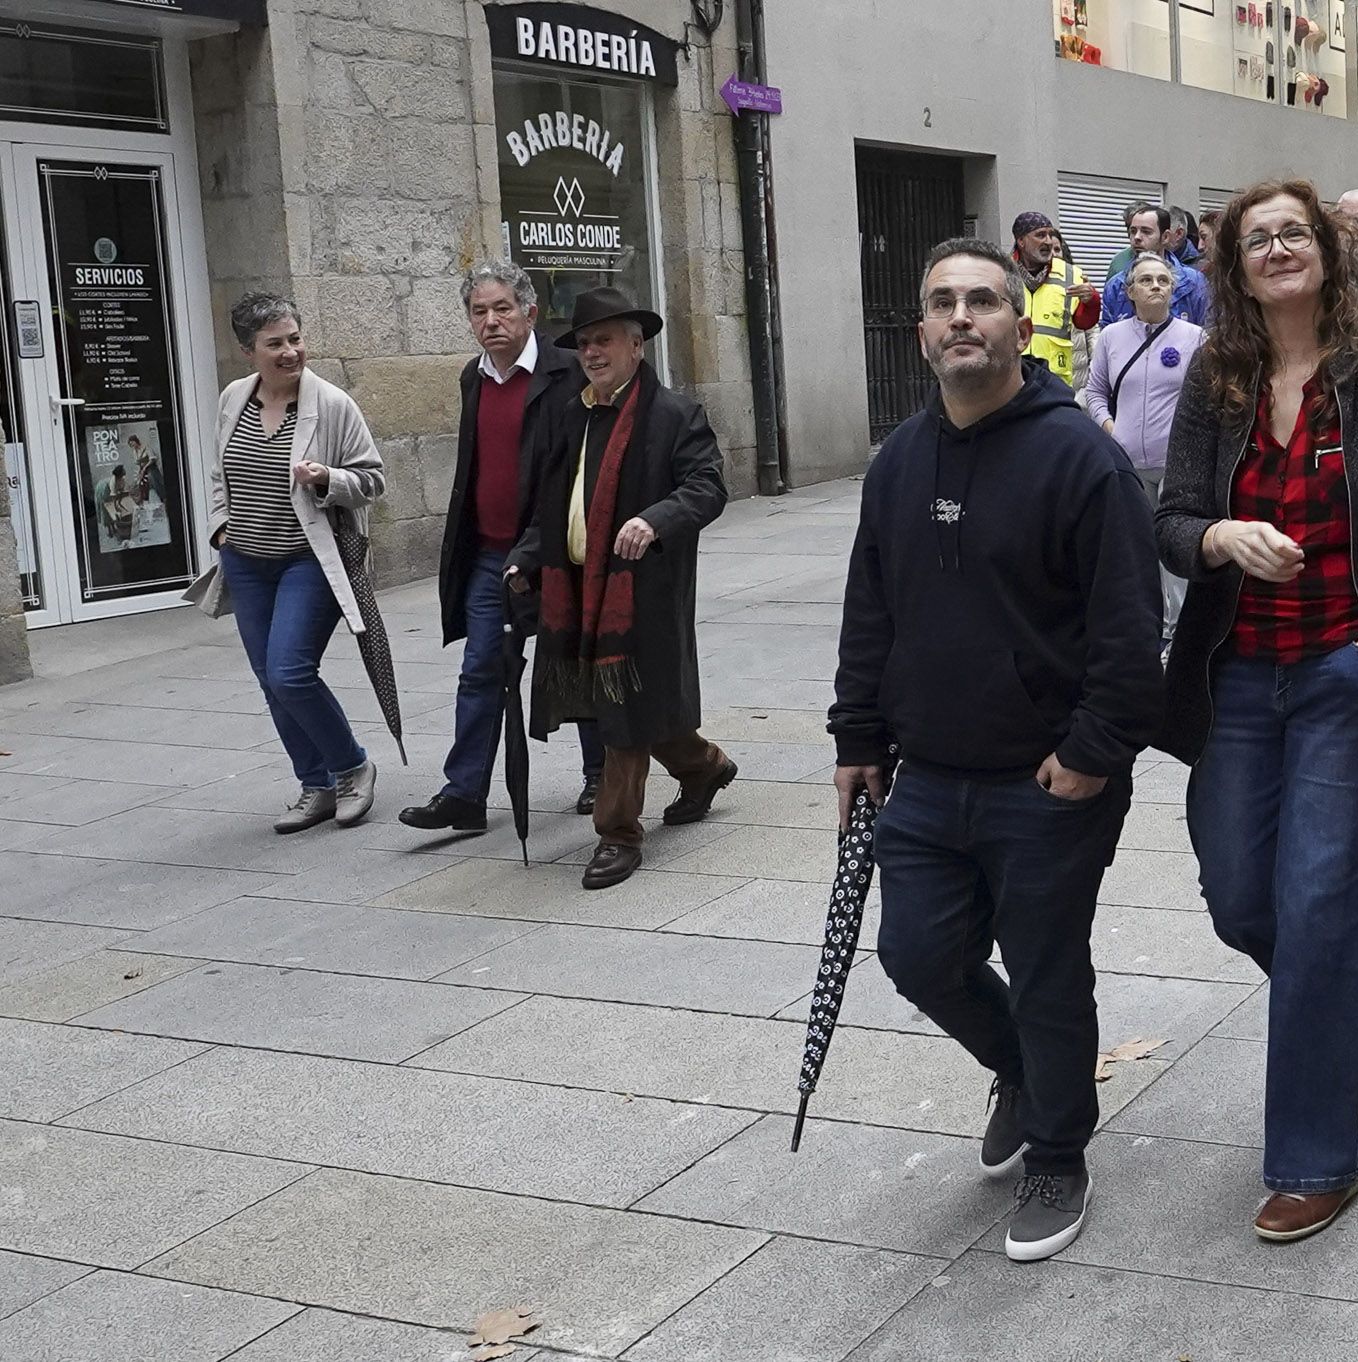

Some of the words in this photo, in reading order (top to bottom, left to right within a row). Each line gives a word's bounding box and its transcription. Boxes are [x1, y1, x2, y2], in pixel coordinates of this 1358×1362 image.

[516, 17, 656, 77] BARBERÍA
[923, 106, 932, 128] 2
[506, 111, 624, 177] BARBERIA
[520, 221, 574, 247] CARLOS
[577, 224, 621, 248] CONDE
[538, 255, 573, 265] PELUQUERÍA
[574, 256, 607, 266] MASCULINA
[75, 267, 144, 285] SERVICIOS
[93, 429, 118, 441] PON
[93, 441, 118, 452] TEA
[95, 451, 119, 462] TRO
